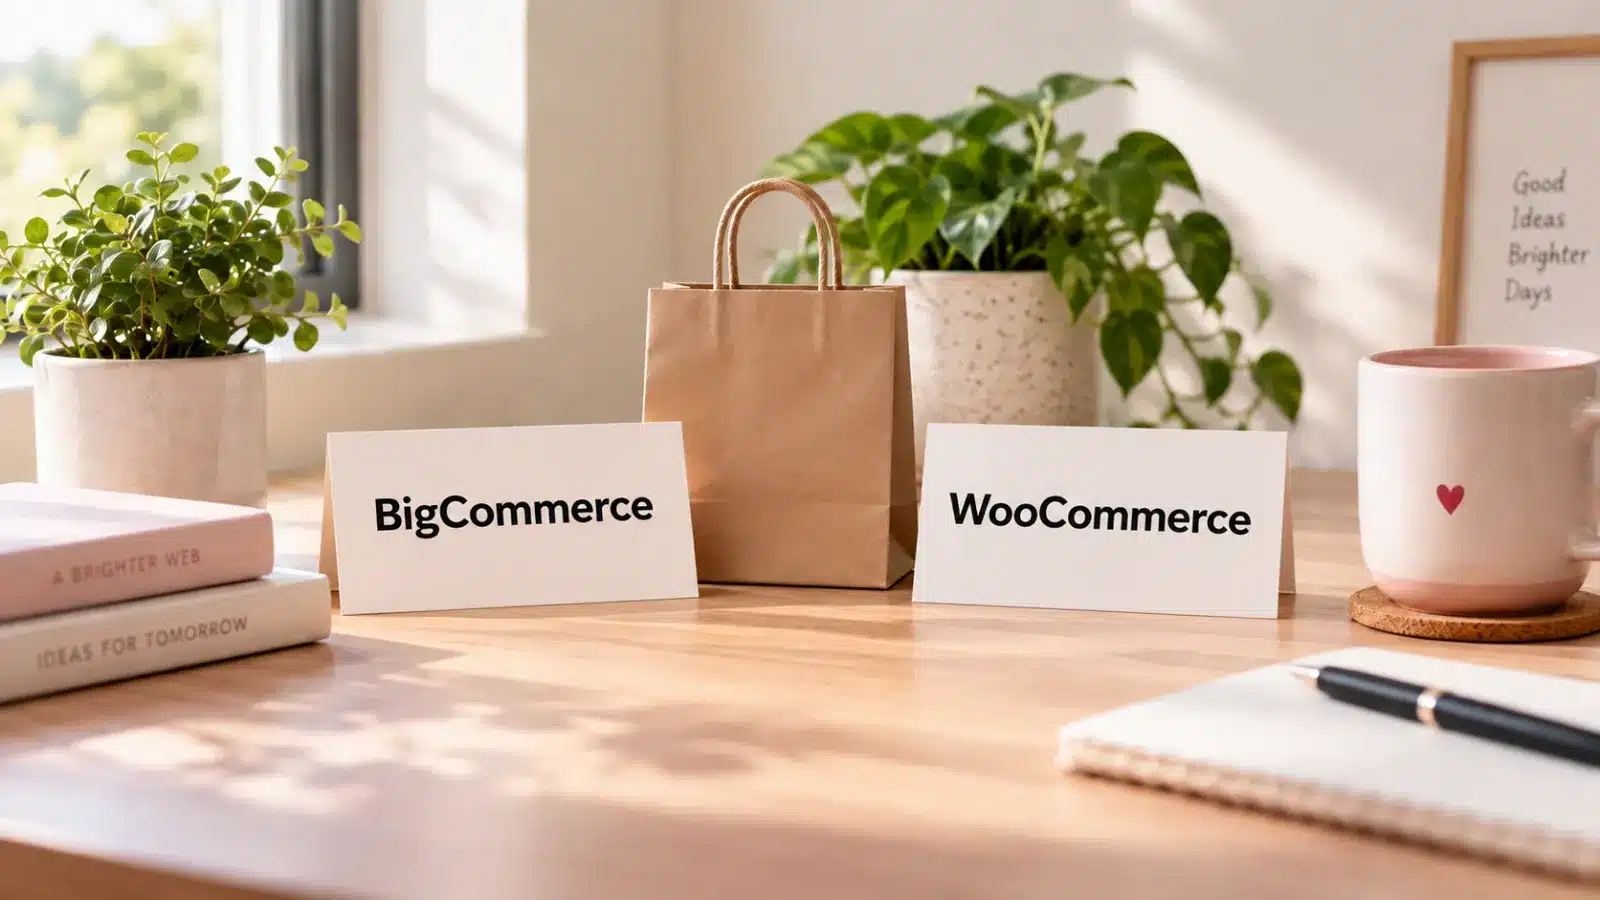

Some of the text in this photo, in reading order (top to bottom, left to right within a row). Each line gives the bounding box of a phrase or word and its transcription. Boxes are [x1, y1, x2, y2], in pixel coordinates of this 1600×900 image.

[1513, 167, 1567, 196] Good
[1511, 205, 1565, 230] Ideas
[1508, 241, 1590, 272] Brighter
[1504, 277, 1552, 310] Days
[374, 495, 653, 539] BigCommerce
[949, 492, 1251, 535] WooCommerce
[52, 548, 201, 585] A BRIGHTER WEB
[37, 616, 248, 670] IDEAS FOR TOMORROW
